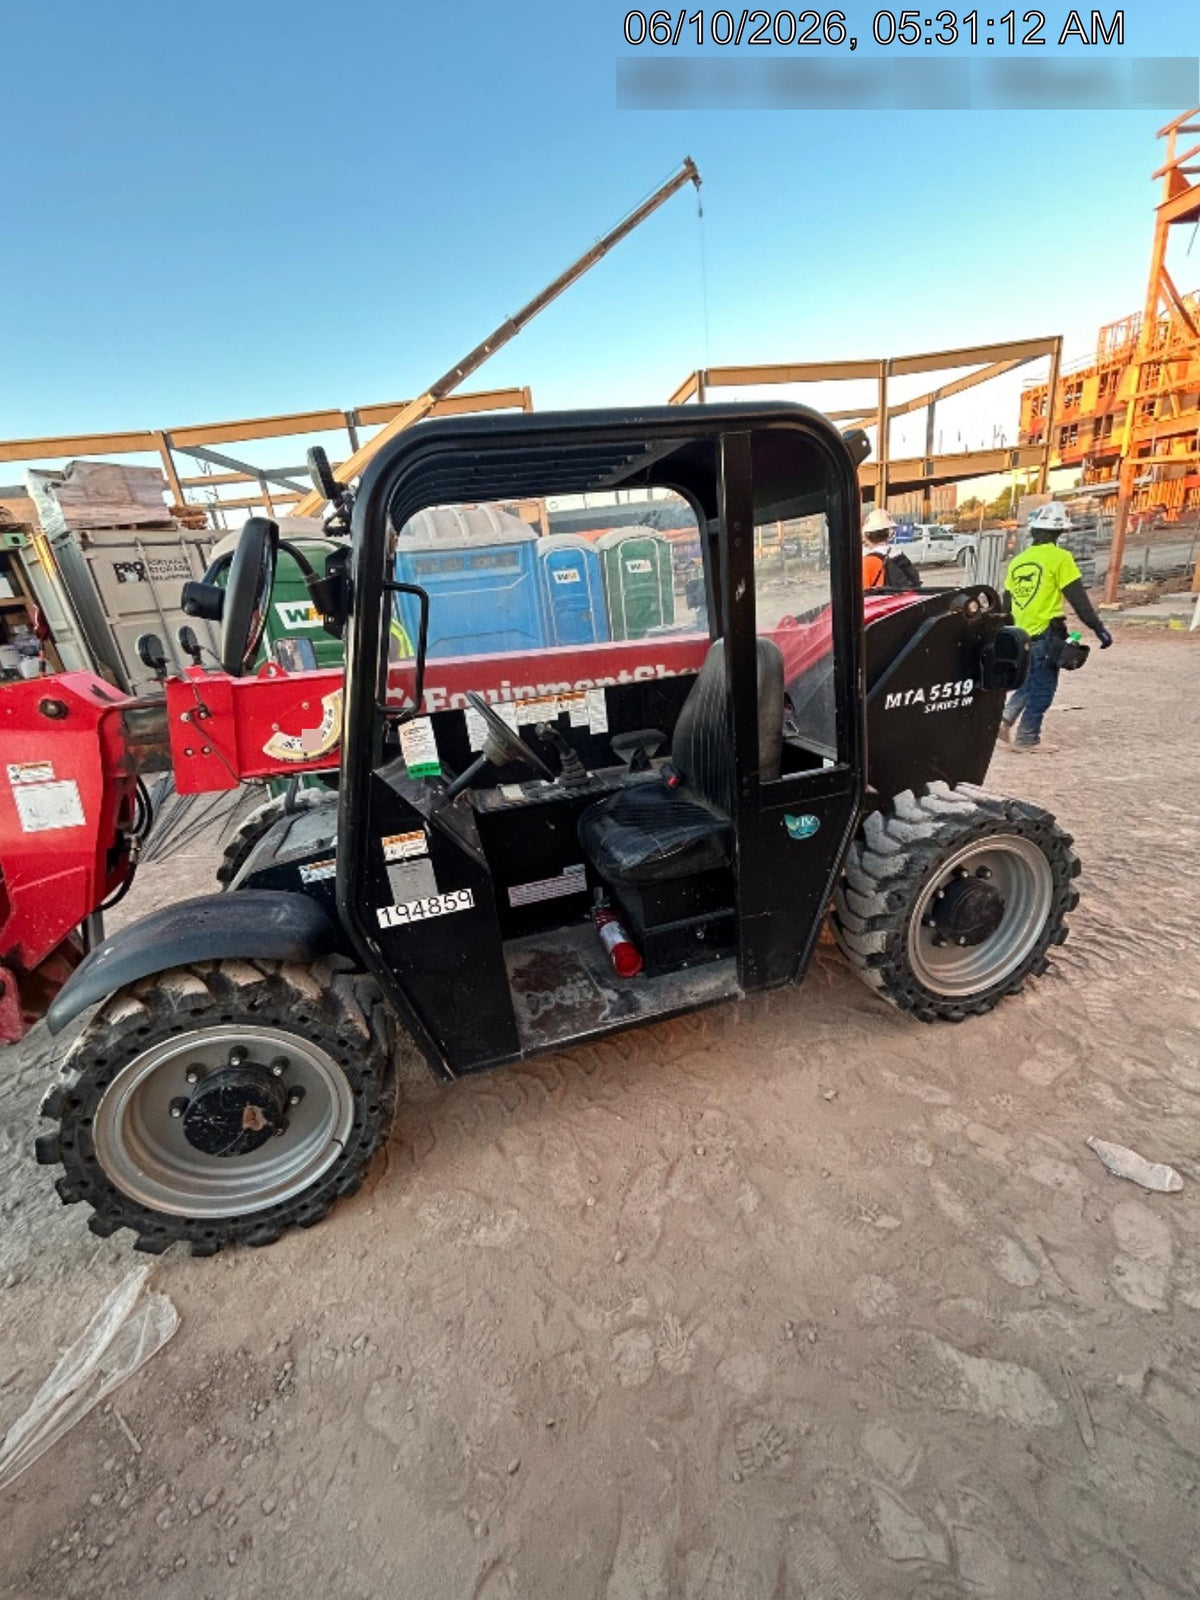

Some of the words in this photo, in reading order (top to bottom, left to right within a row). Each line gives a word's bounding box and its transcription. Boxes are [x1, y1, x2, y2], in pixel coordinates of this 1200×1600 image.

[113, 561, 145, 573] PRO
[885, 688, 925, 710] MTA
[929, 678, 974, 701] 5519
[381, 890, 472, 924] 194859
